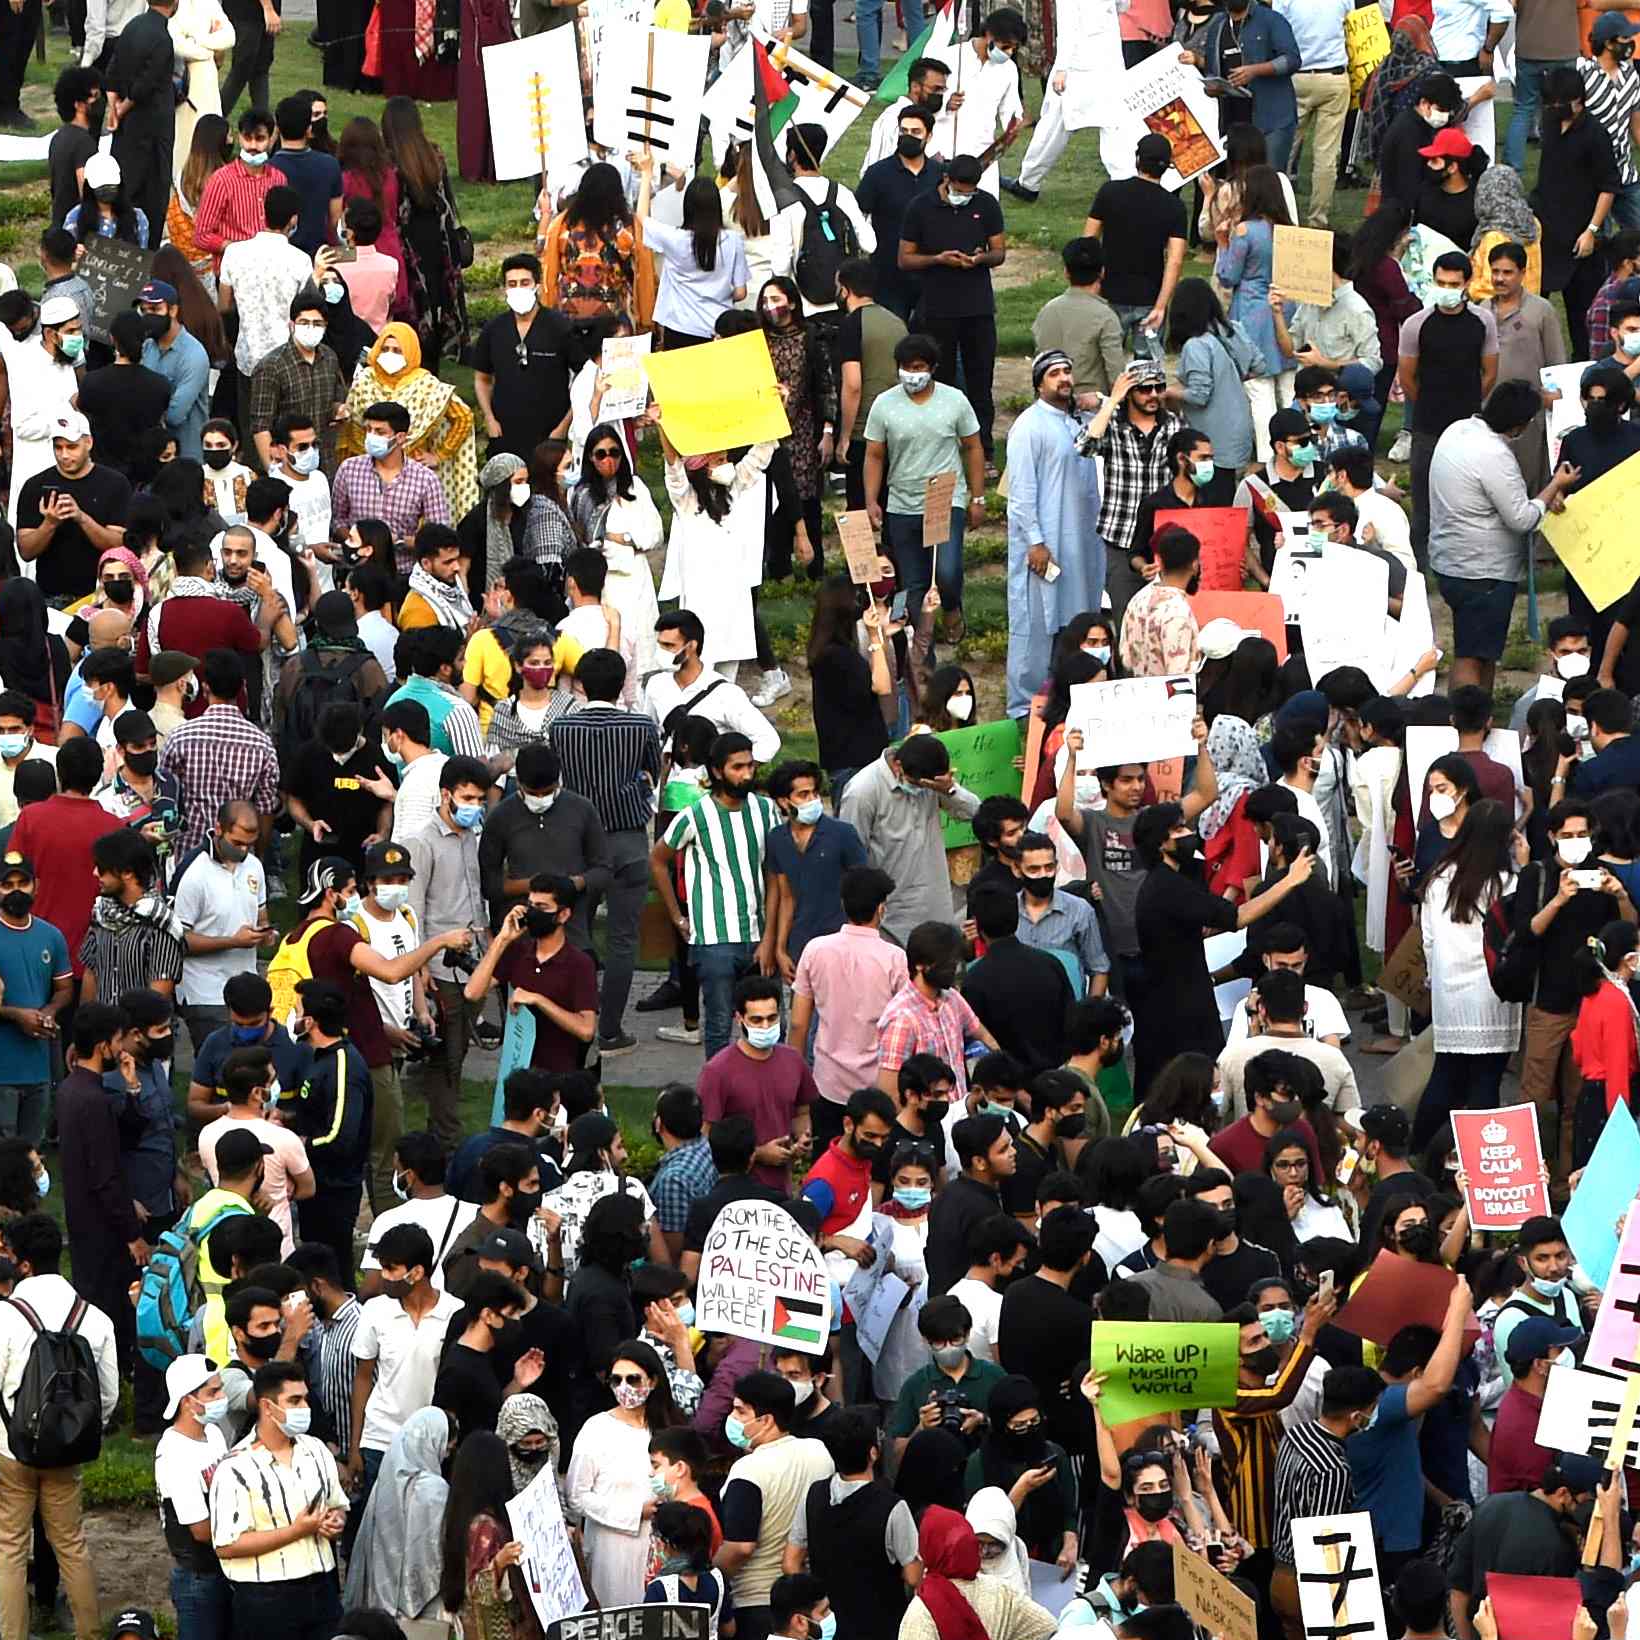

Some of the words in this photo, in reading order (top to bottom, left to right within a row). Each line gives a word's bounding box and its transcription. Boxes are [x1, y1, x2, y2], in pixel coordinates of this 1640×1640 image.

[1479, 1144, 1517, 1161] KEEP
[1479, 1157, 1521, 1175] CALM
[1473, 1184, 1536, 1203] BOYCOTT
[721, 1207, 759, 1228] ROM
[761, 1208, 786, 1232] THE
[1483, 1199, 1531, 1217] ISRAEL
[708, 1231, 727, 1253] TO
[734, 1230, 772, 1256] THE
[774, 1239, 818, 1269] SEA
[710, 1255, 826, 1298] PALESTINE
[701, 1283, 741, 1302] WILL
[747, 1286, 765, 1307] BE
[1173, 1344, 1205, 1368] UP!
[1127, 1363, 1198, 1382] Muslim
[663, 1612, 701, 1640] IN
